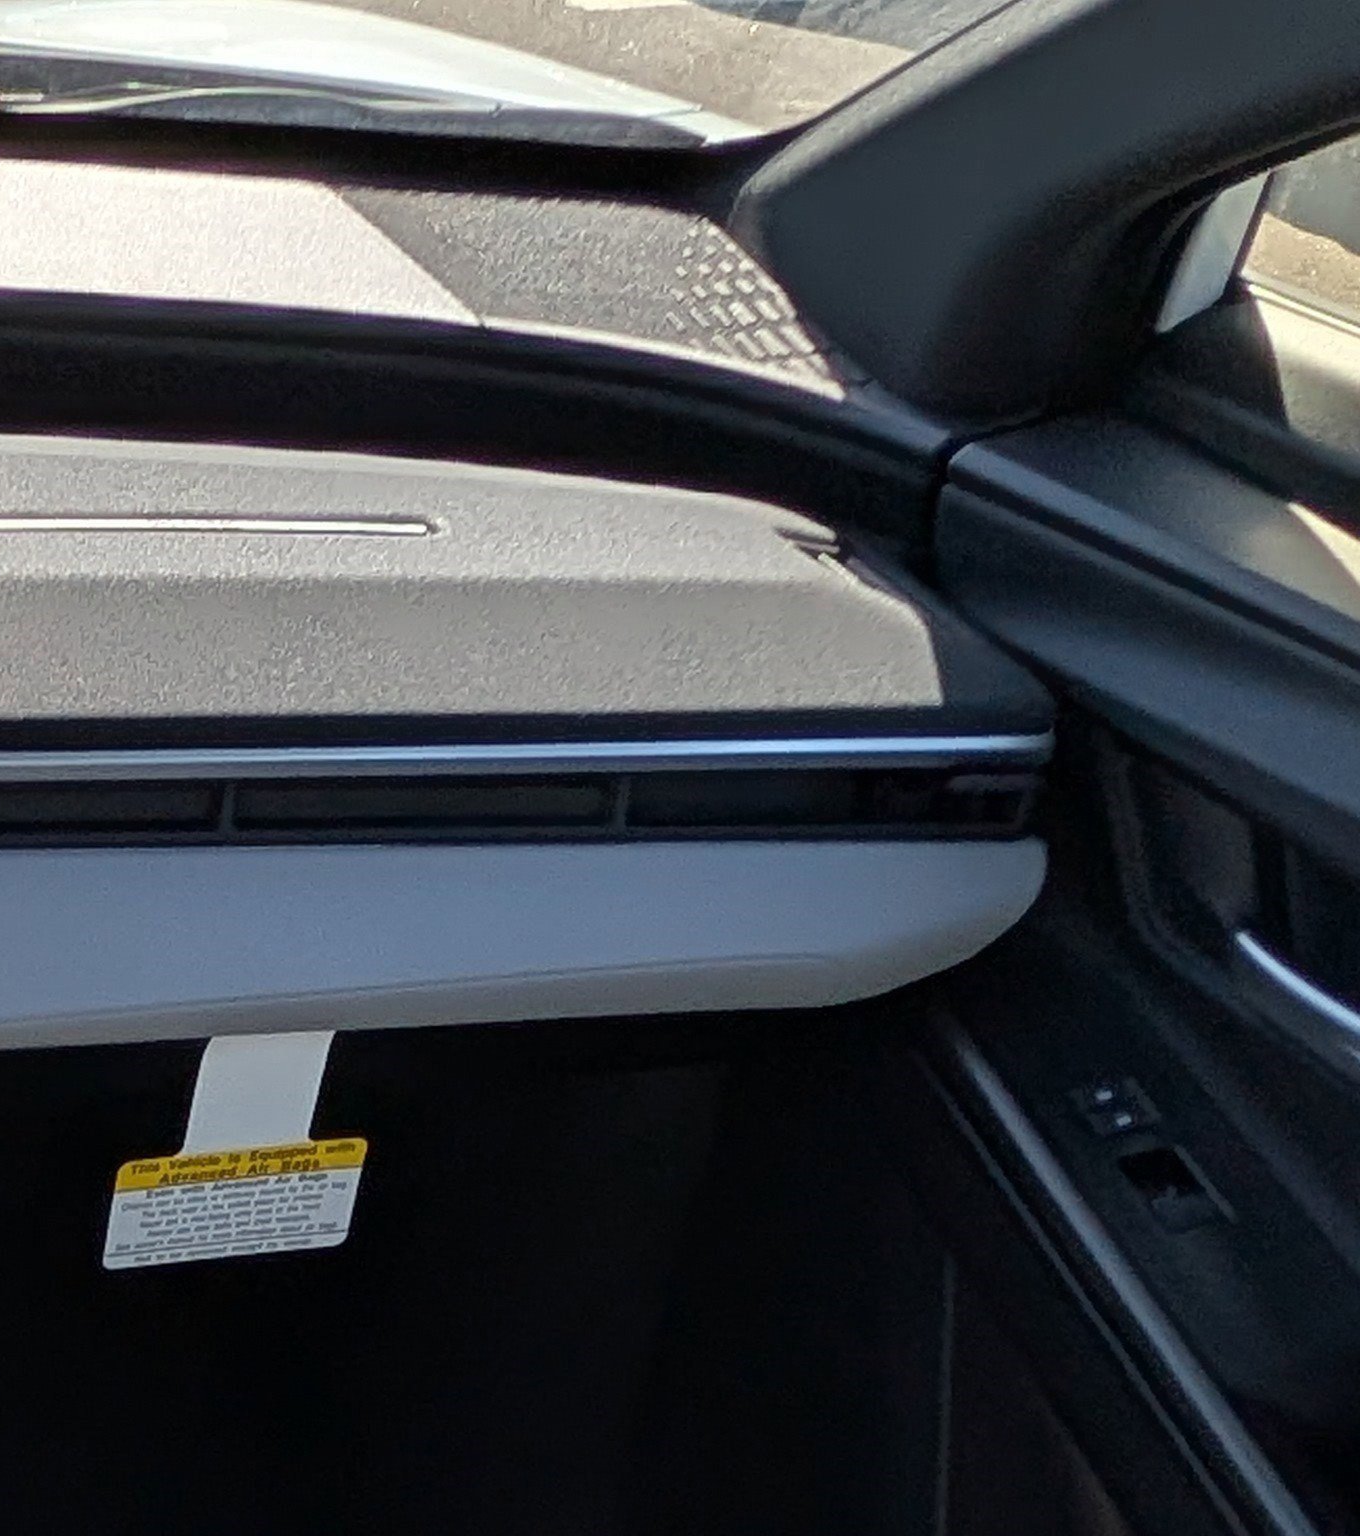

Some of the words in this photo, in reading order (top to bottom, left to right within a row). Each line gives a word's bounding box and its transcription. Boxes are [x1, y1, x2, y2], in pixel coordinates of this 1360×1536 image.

[131, 1162, 160, 1175] This
[169, 1154, 222, 1170] Vehicle
[249, 1144, 318, 1162] Equipped
[325, 1143, 356, 1154] with
[159, 1164, 238, 1185] Advanced
[248, 1162, 270, 1175] Air
[281, 1158, 320, 1172] Bags
